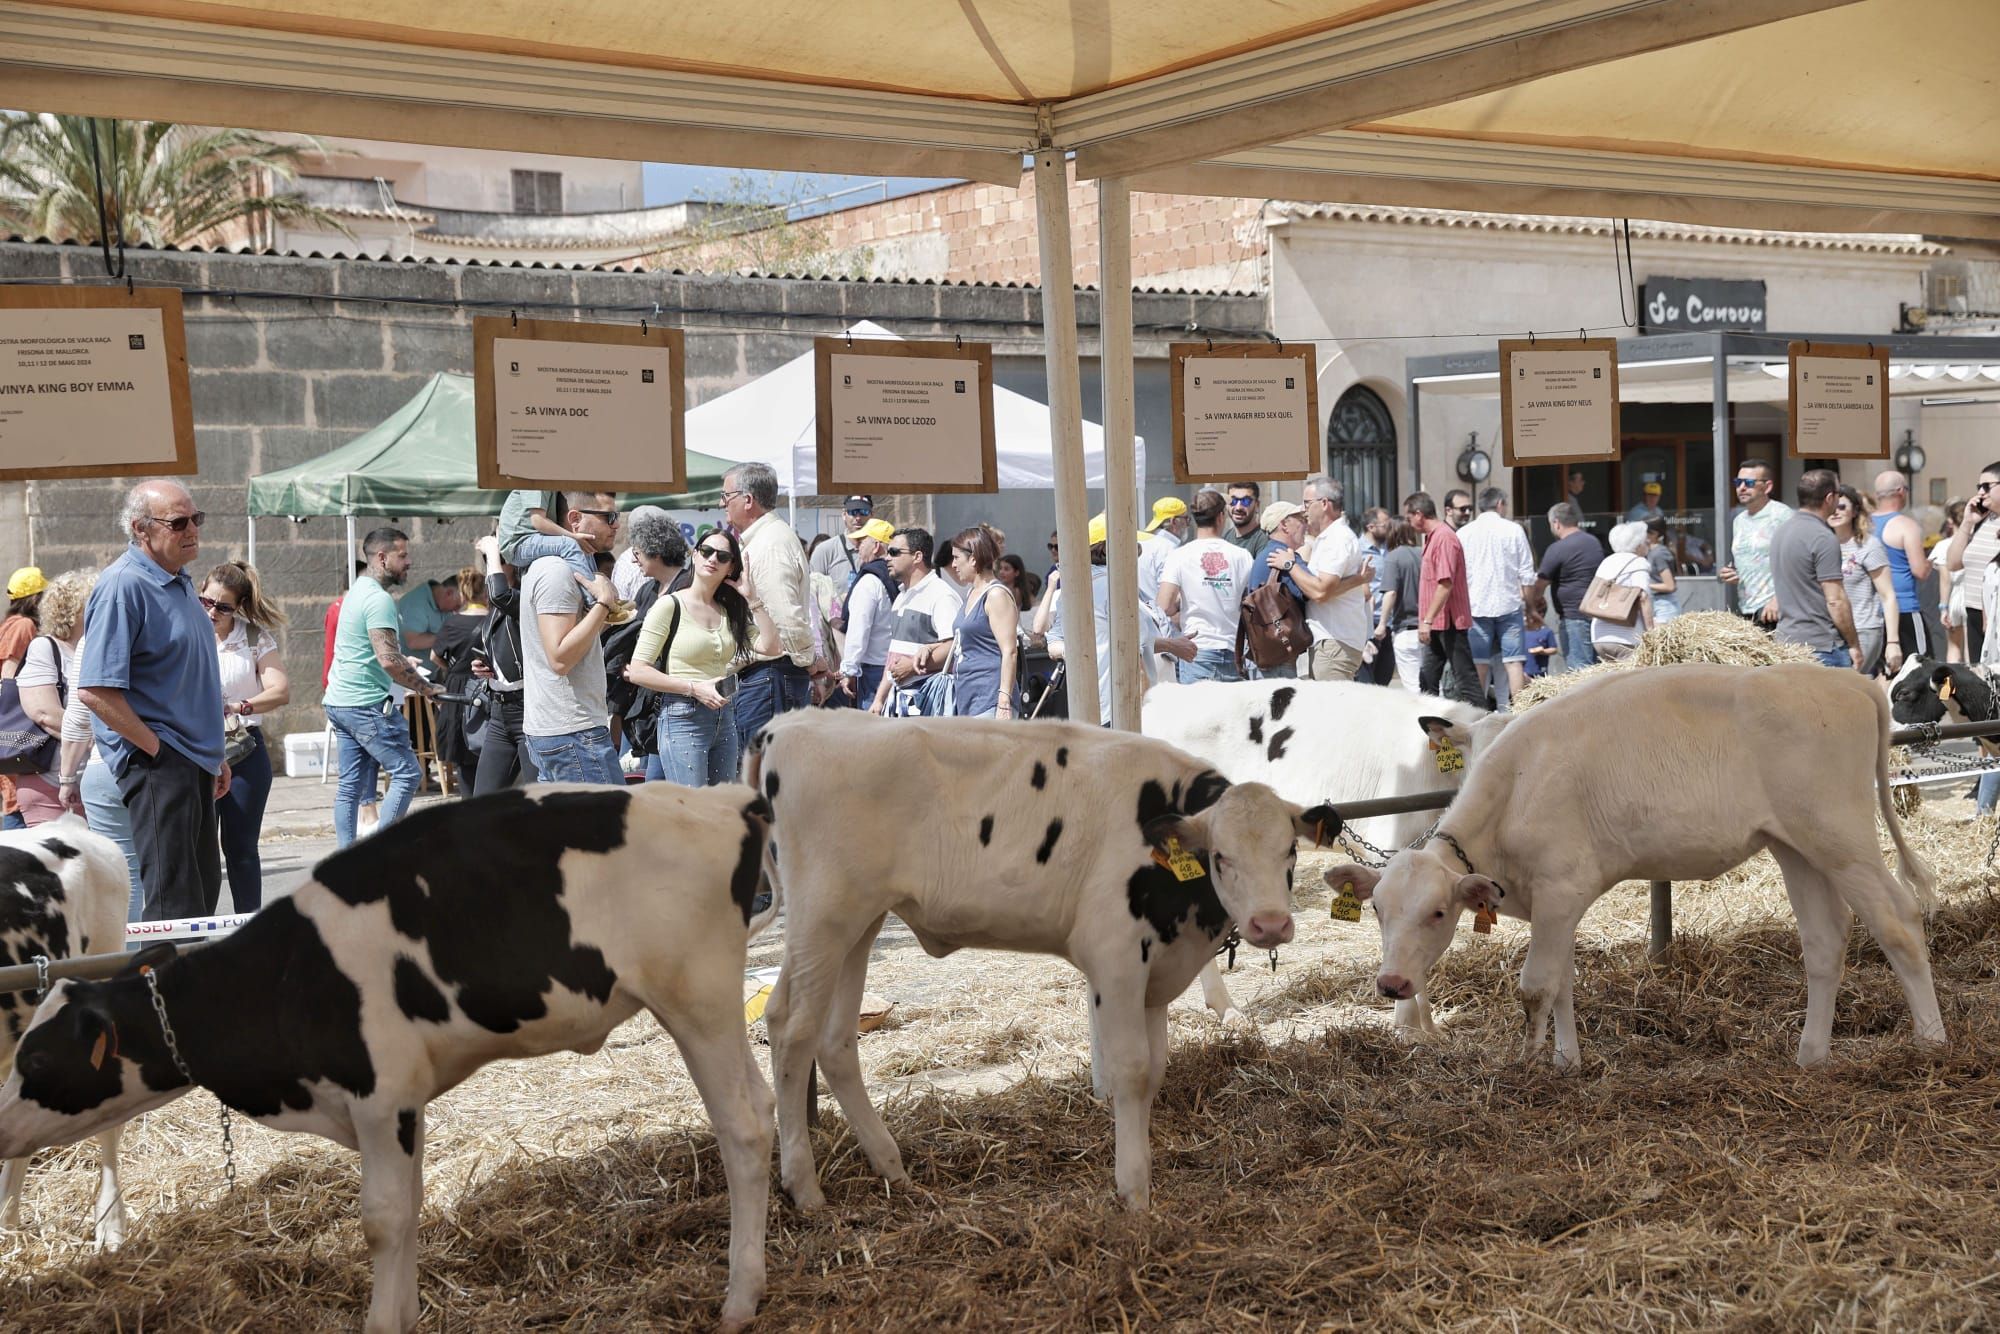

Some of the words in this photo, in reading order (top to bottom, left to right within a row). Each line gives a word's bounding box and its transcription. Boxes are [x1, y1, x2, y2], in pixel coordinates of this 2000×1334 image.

[1649, 291, 1679, 324] Sa
[1686, 294, 1763, 323] Canova
[38, 383, 67, 394] KING
[70, 382, 94, 392] BOY
[97, 381, 135, 392] EMMA
[525, 406, 538, 416] SA
[538, 407, 568, 416] VINYA
[569, 408, 589, 417] DOC
[856, 416, 866, 424] SA
[868, 416, 892, 425] VINYA
[894, 417, 910, 425] DOC
[912, 418, 936, 426] LZOZO
